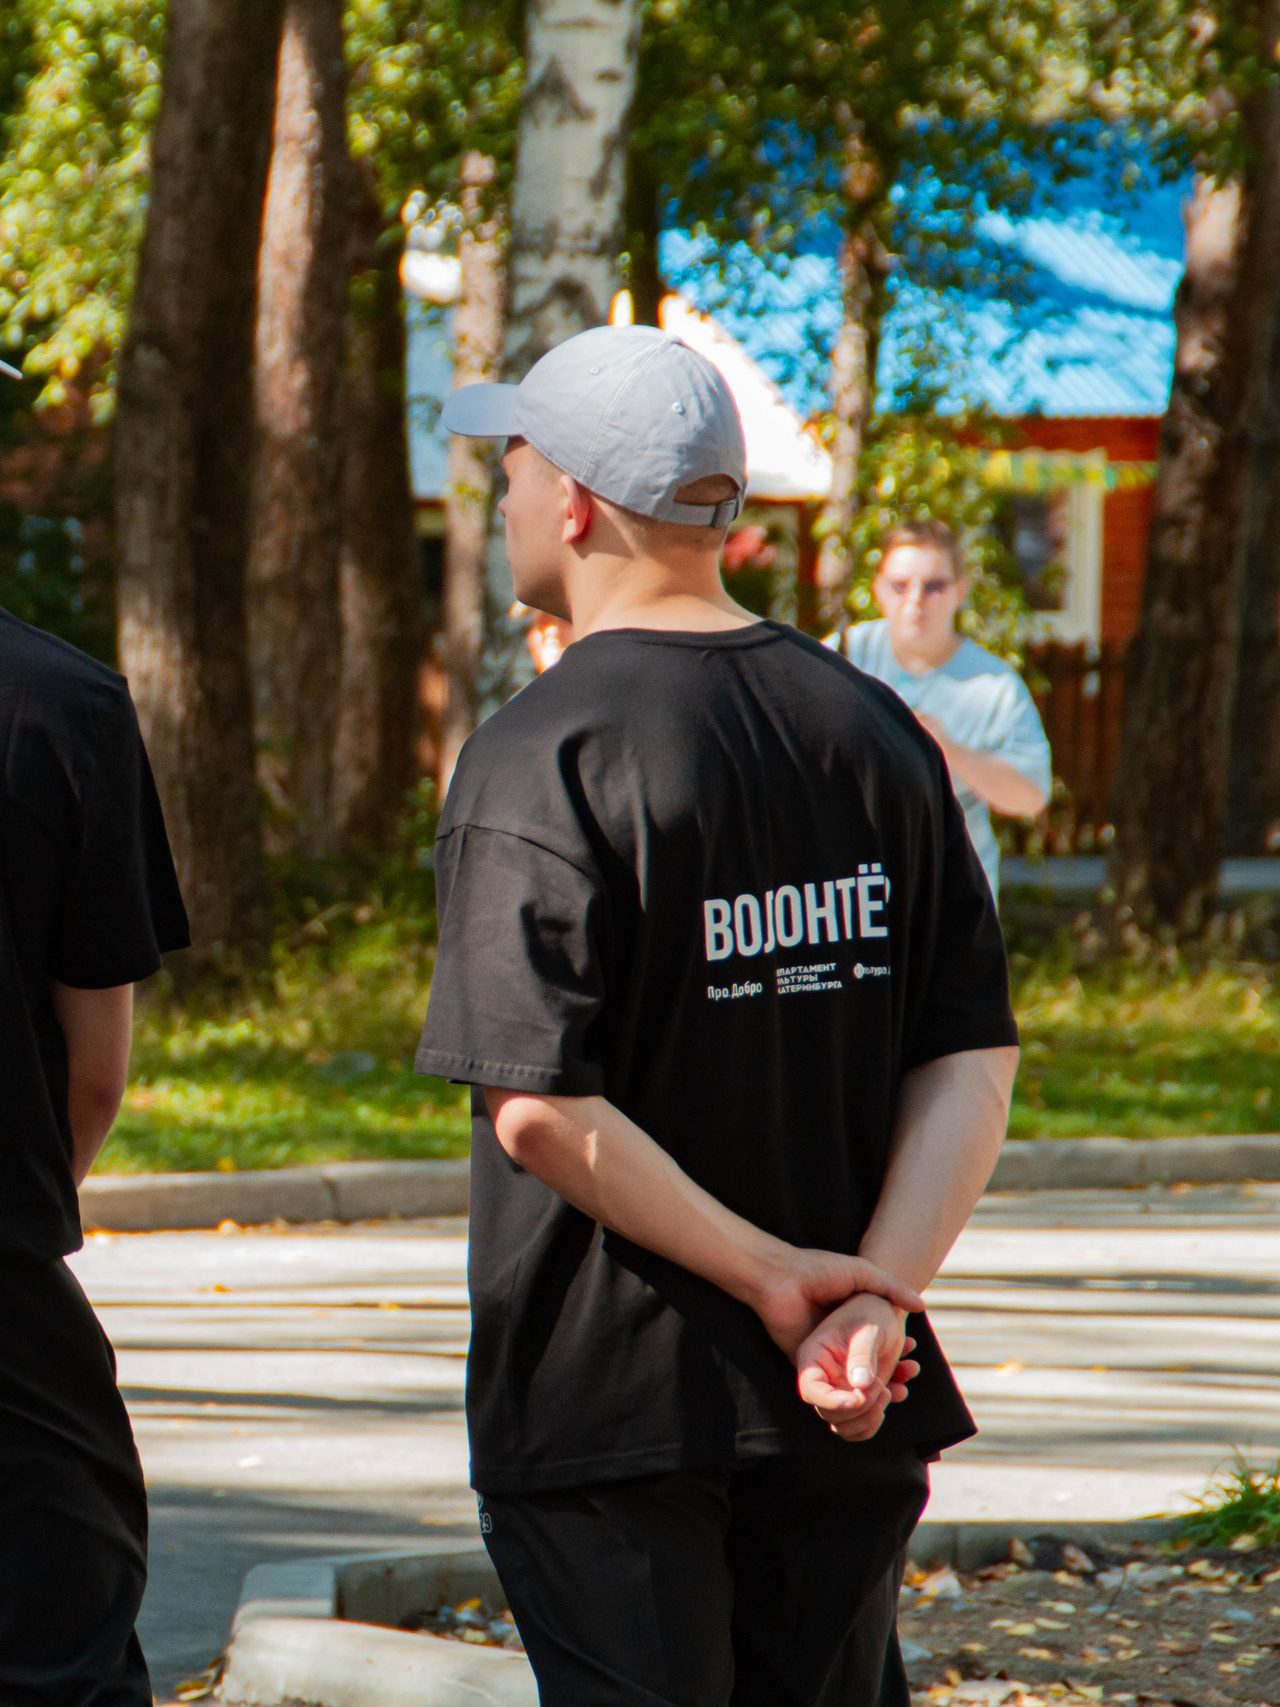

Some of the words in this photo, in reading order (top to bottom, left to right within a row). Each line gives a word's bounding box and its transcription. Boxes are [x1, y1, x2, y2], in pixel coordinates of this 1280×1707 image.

[776, 963, 837, 977] ЕПАРТАМЕНТ
[777, 974, 819, 985] ЛЬТУРЫ
[778, 980, 843, 995] АТЕРИНБУРГА
